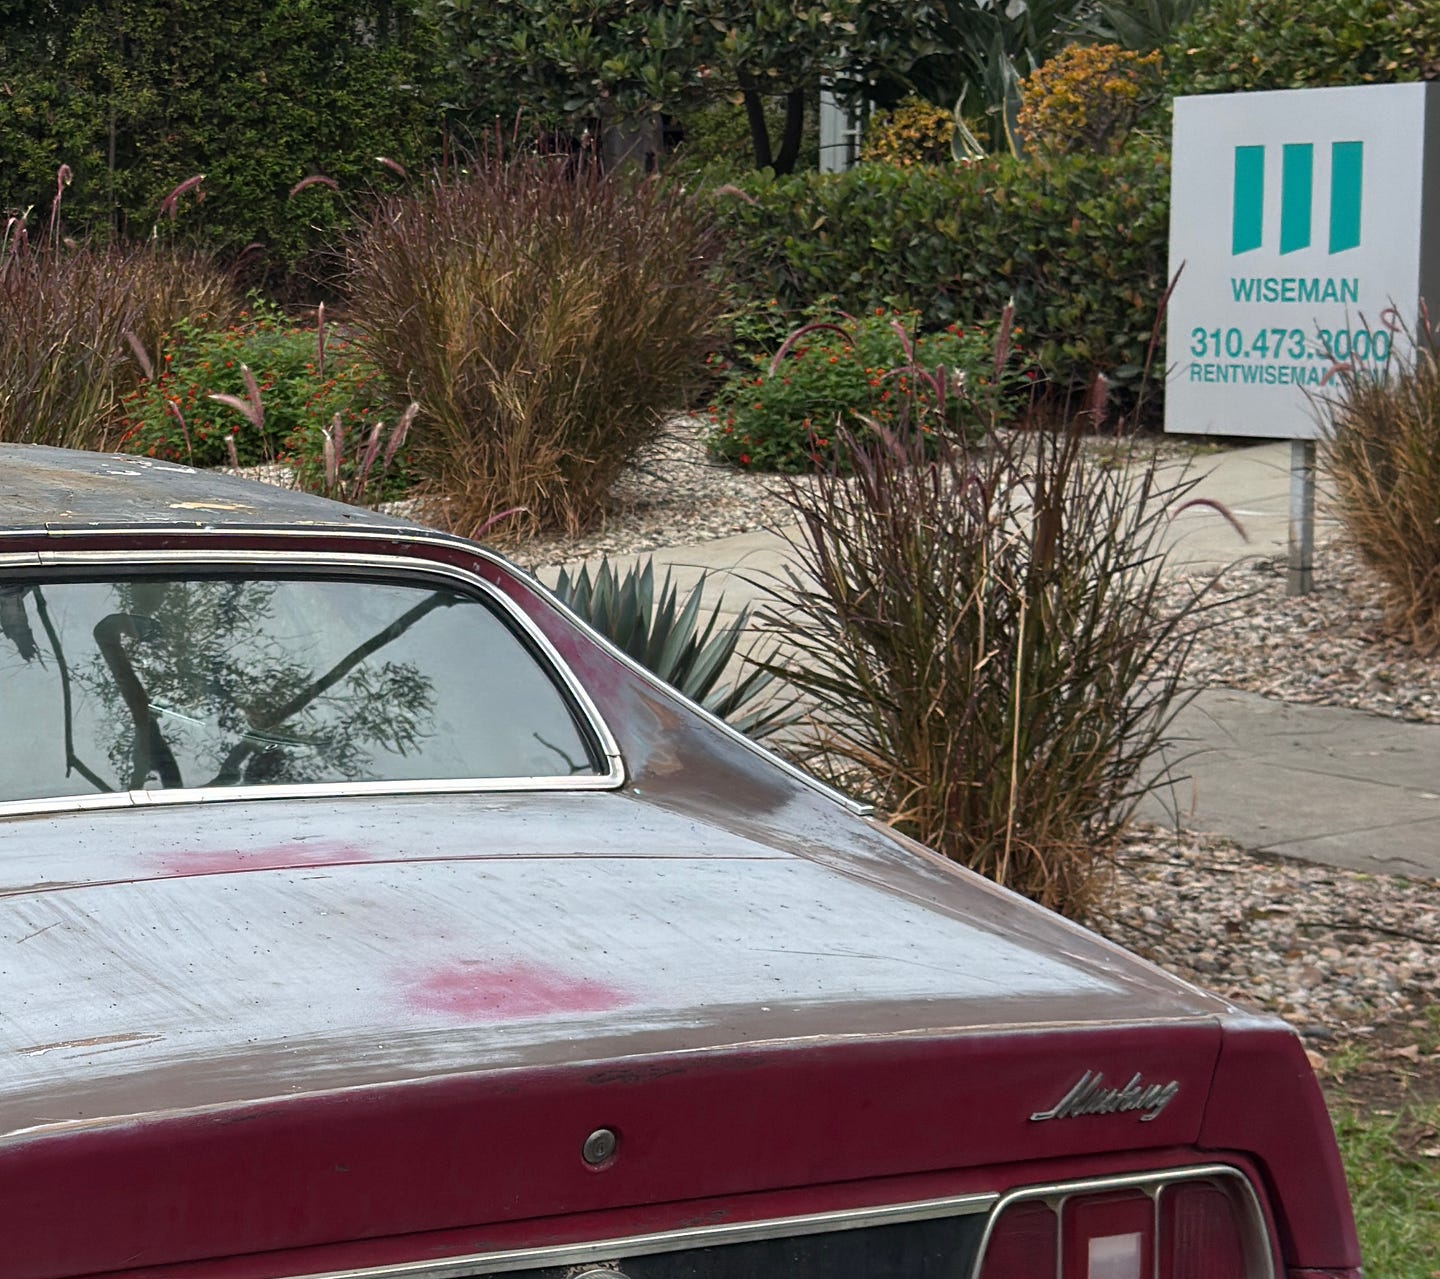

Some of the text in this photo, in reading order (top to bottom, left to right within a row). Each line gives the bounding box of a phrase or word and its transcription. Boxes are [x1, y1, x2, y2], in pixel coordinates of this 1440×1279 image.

[1231, 277, 1359, 304] WISEMAN
[1190, 326, 1390, 362] 310.473.3000
[1189, 362, 1388, 389] RENTWISEMAN.
[1029, 1069, 1179, 1122] Mustang
